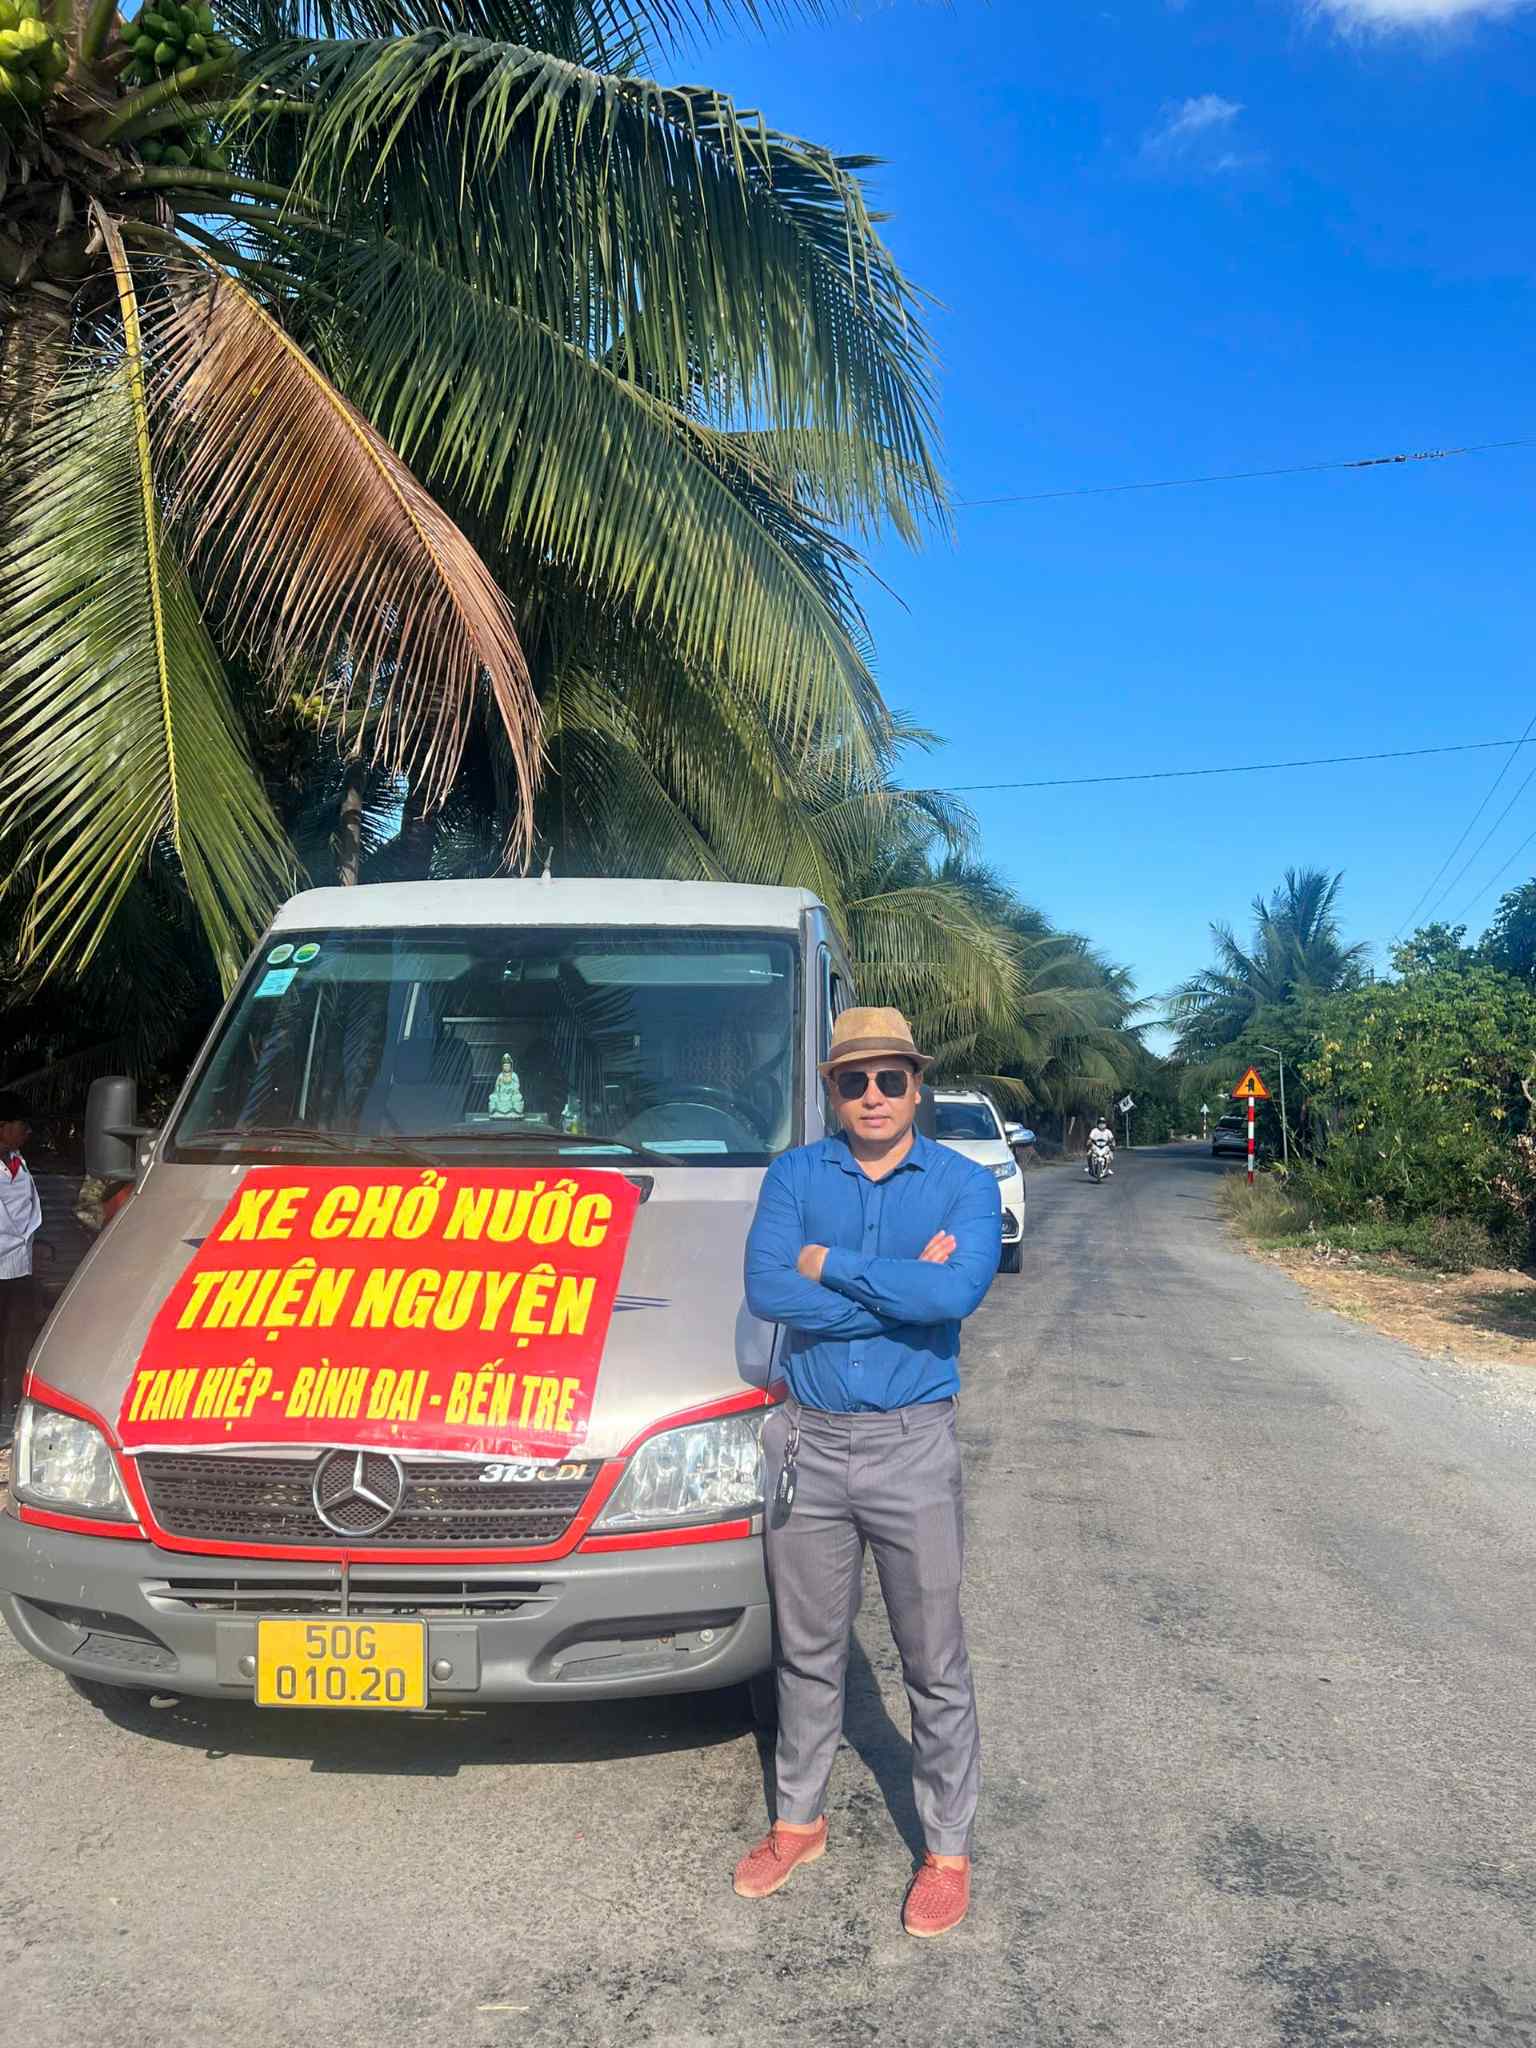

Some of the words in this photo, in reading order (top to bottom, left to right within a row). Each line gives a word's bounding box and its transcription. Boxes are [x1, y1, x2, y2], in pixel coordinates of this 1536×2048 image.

[217, 1186, 310, 1241] XE
[310, 1169, 448, 1241] CHỞ
[442, 1178, 613, 1248] NƯỚC
[176, 1256, 356, 1342] THIỆN
[350, 1262, 597, 1348] NGUYỆN
[128, 1368, 200, 1422] TAM
[191, 1357, 273, 1432] HIỆP
[284, 1357, 370, 1419] BÌNH
[365, 1368, 430, 1436] ĐẠI
[444, 1357, 517, 1428] BẾN
[517, 1375, 581, 1433] TRE
[478, 1463, 537, 1483] 313
[536, 1463, 588, 1482] CDI
[306, 1625, 376, 1660] 50G
[276, 1665, 406, 1702] 010.20
